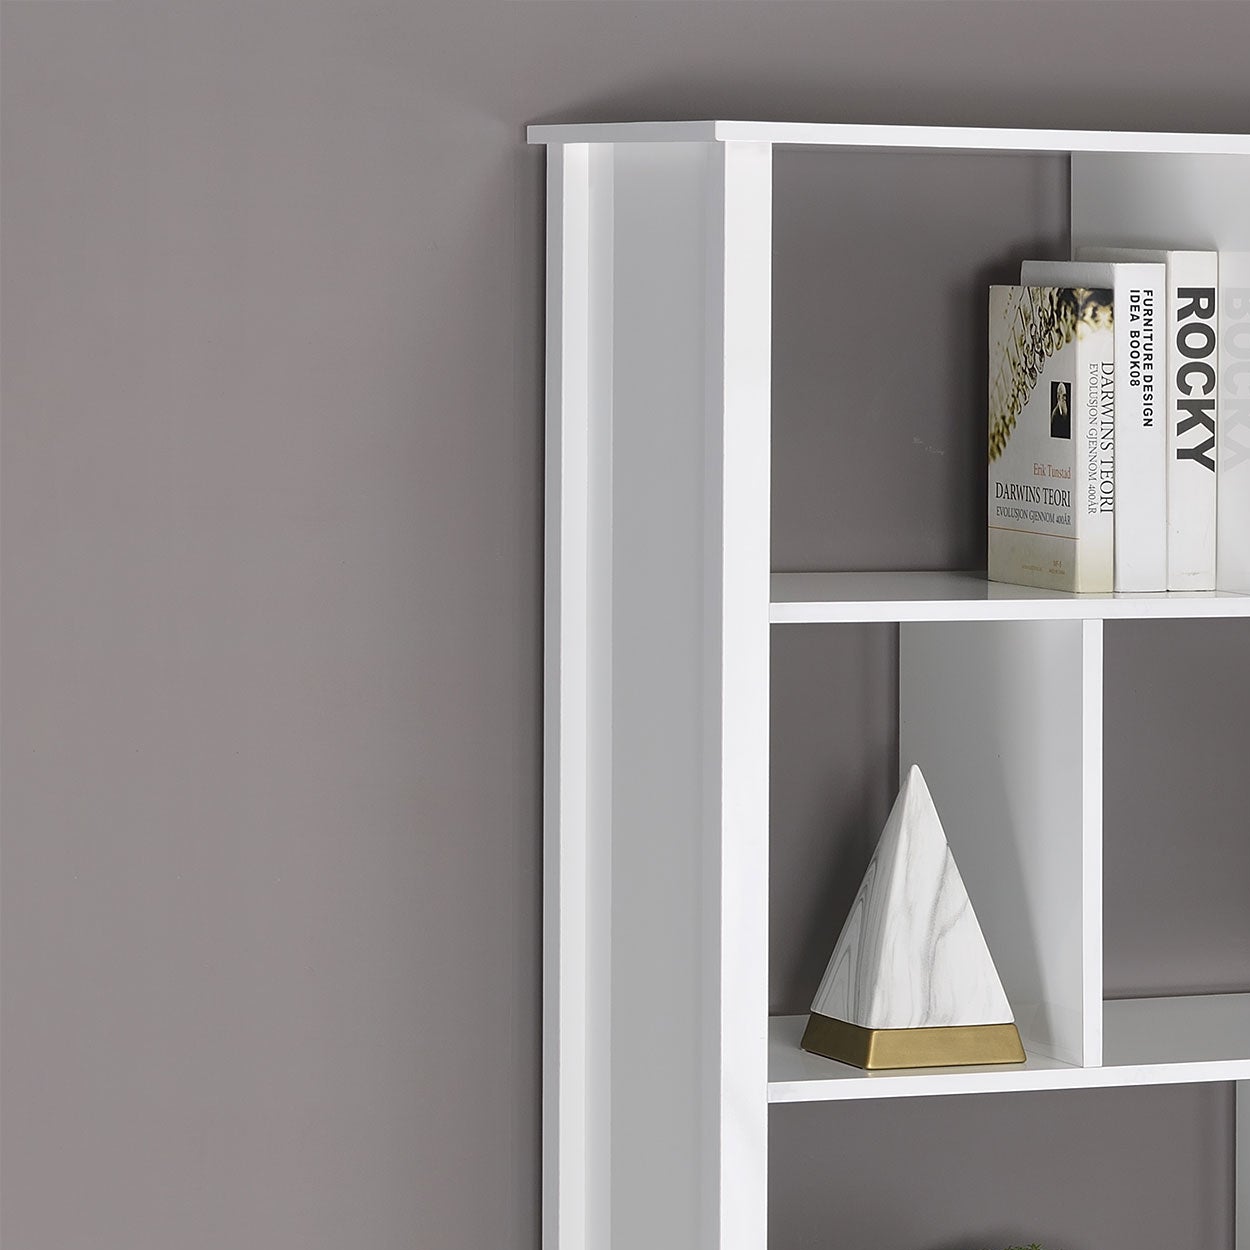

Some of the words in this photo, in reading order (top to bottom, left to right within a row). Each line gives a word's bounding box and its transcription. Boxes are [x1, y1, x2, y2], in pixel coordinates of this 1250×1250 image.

[1130, 289, 1140, 322] IDEA
[1143, 289, 1153, 371] FURNITURE
[1129, 330, 1140, 387] BOOK08
[1176, 287, 1216, 473] ROCKY
[1086, 363, 1099, 425] EVOLUSJON
[1100, 361, 1114, 451] DARWINS
[1143, 375, 1153, 427] DESIGN
[1086, 428, 1098, 481] GJENNOM
[995, 482, 1041, 504] DARWINS
[1043, 487, 1071, 507] TEORI
[1100, 456, 1114, 513] TEORI
[996, 506, 1028, 521] EVOLUSJON
